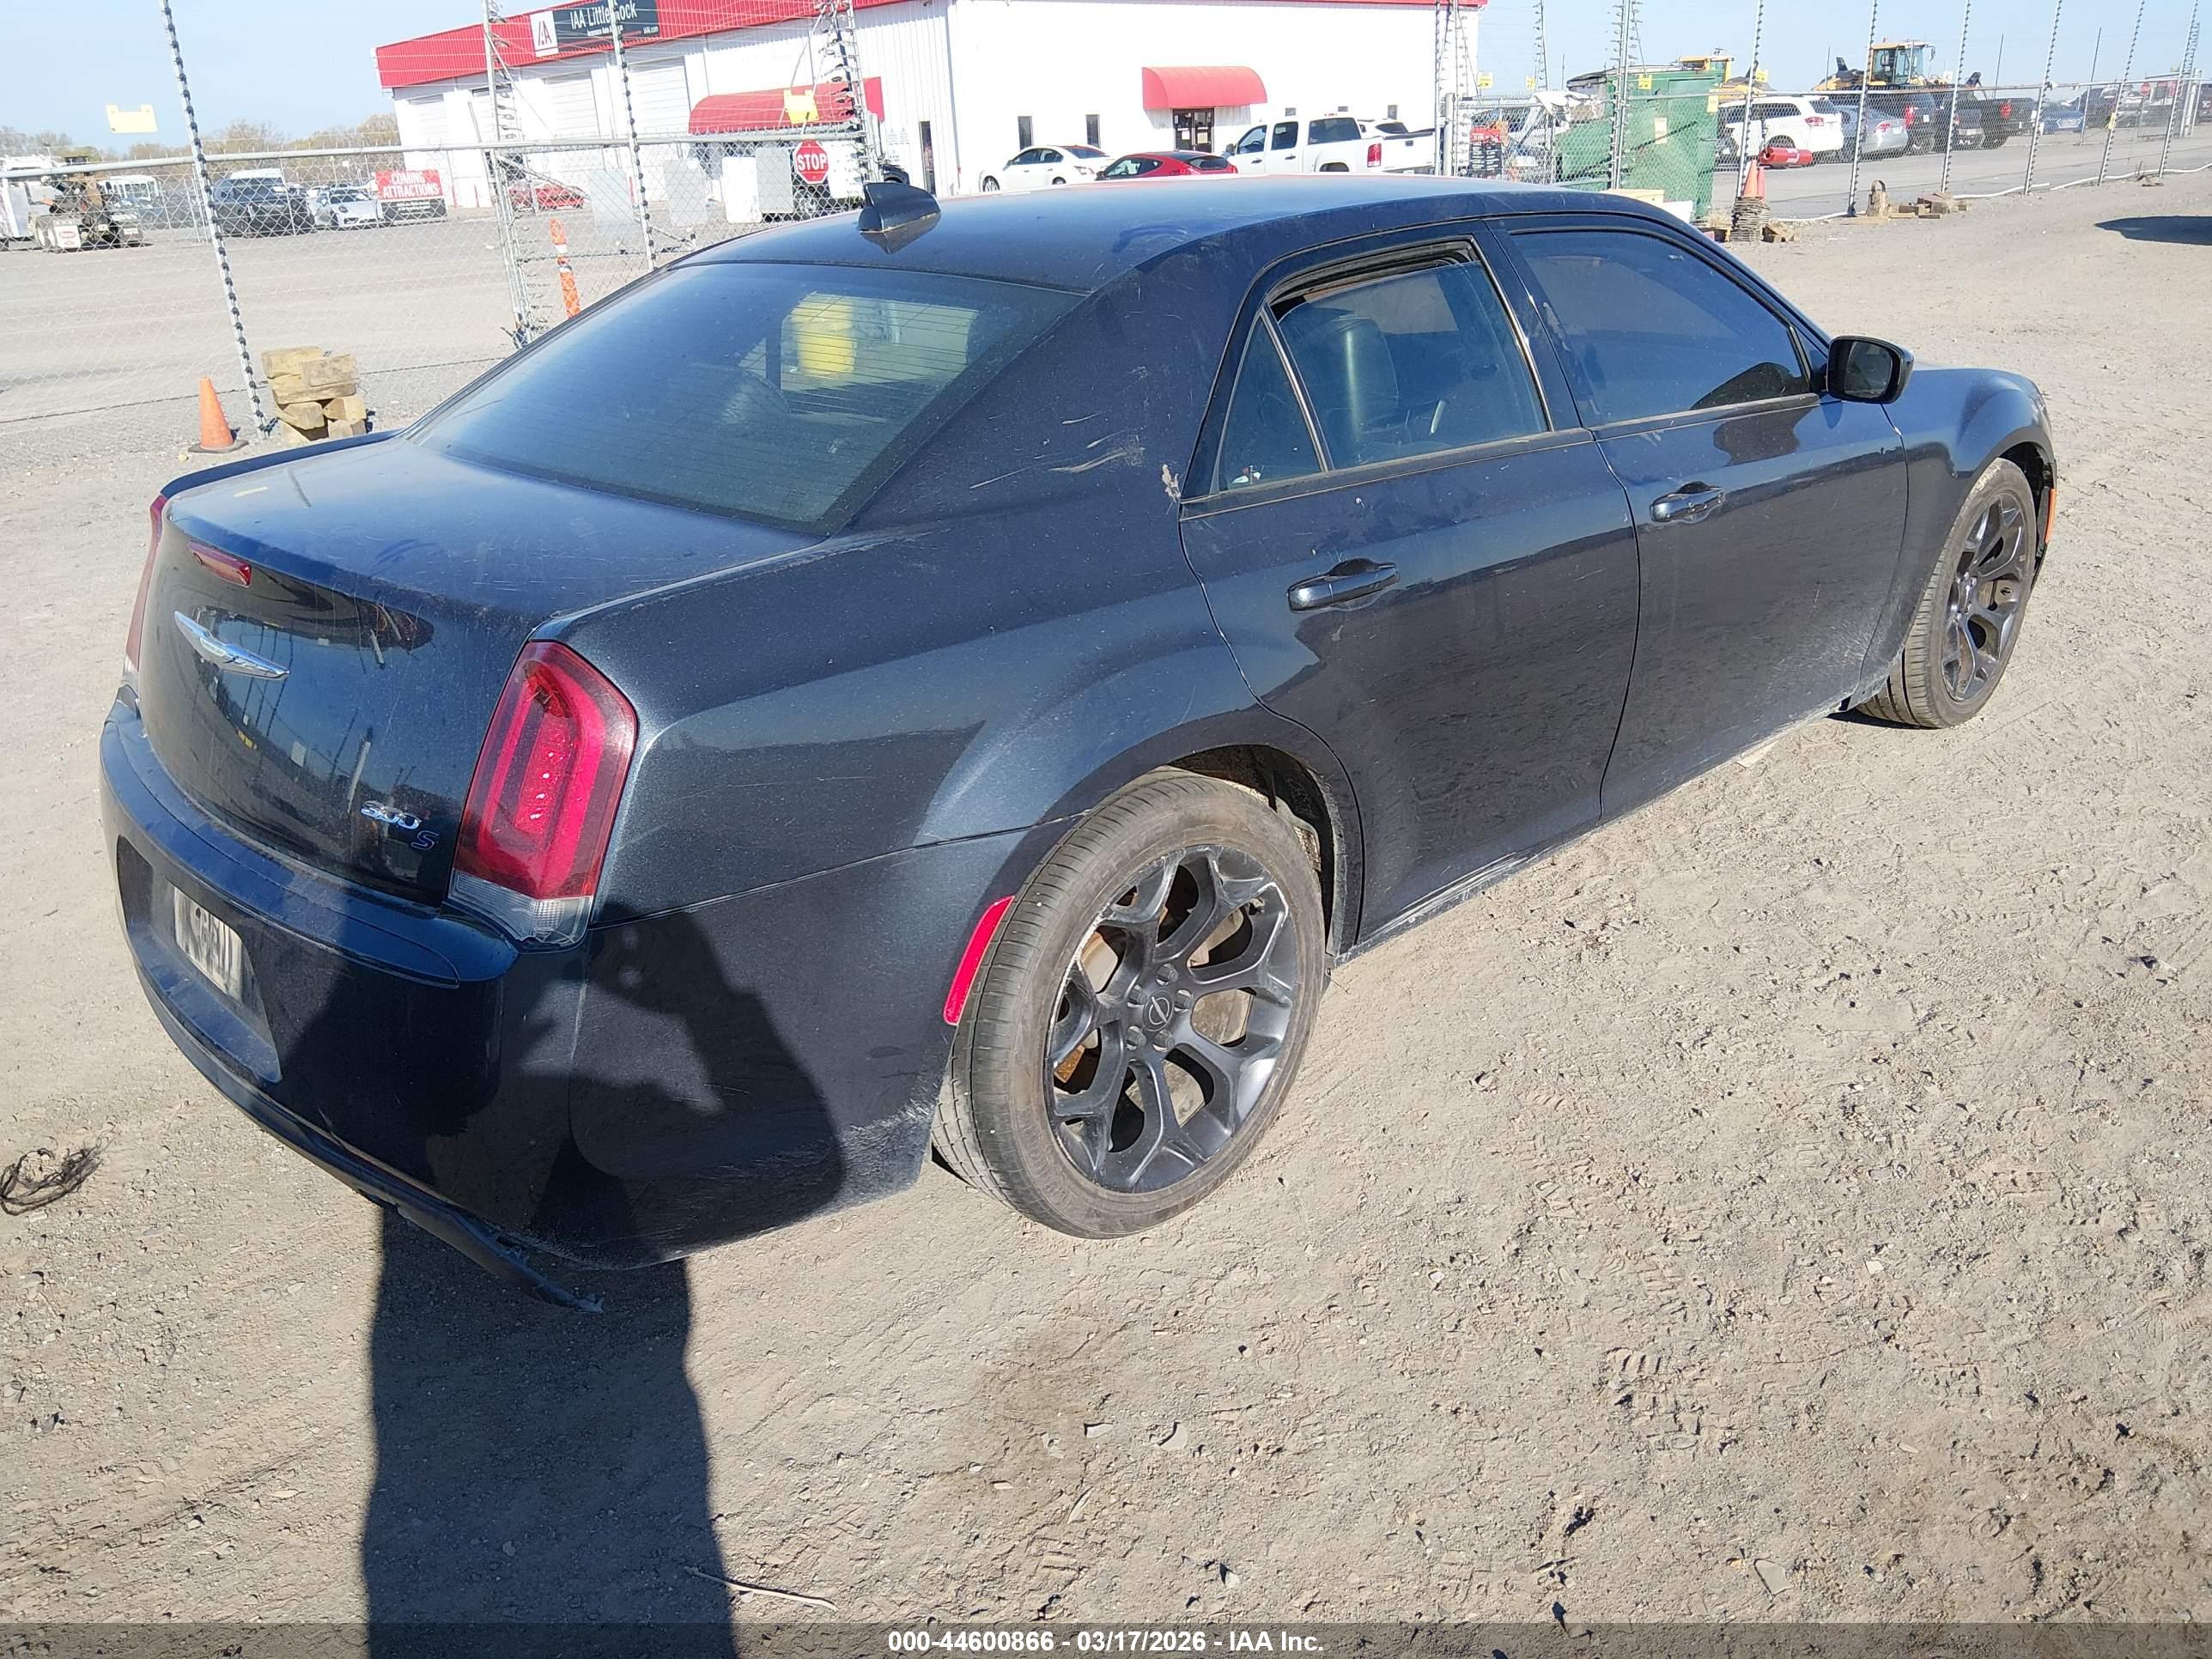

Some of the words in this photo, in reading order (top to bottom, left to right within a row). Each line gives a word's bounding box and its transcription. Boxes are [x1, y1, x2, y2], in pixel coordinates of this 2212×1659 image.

[570, 11, 586, 29] IAA
[587, 6, 611, 27] Little
[797, 153, 827, 172] STOP
[391, 172, 426, 185] COMING
[383, 182, 440, 198] ATTRACTIONS
[361, 799, 422, 830] 300
[410, 830, 440, 851] S
